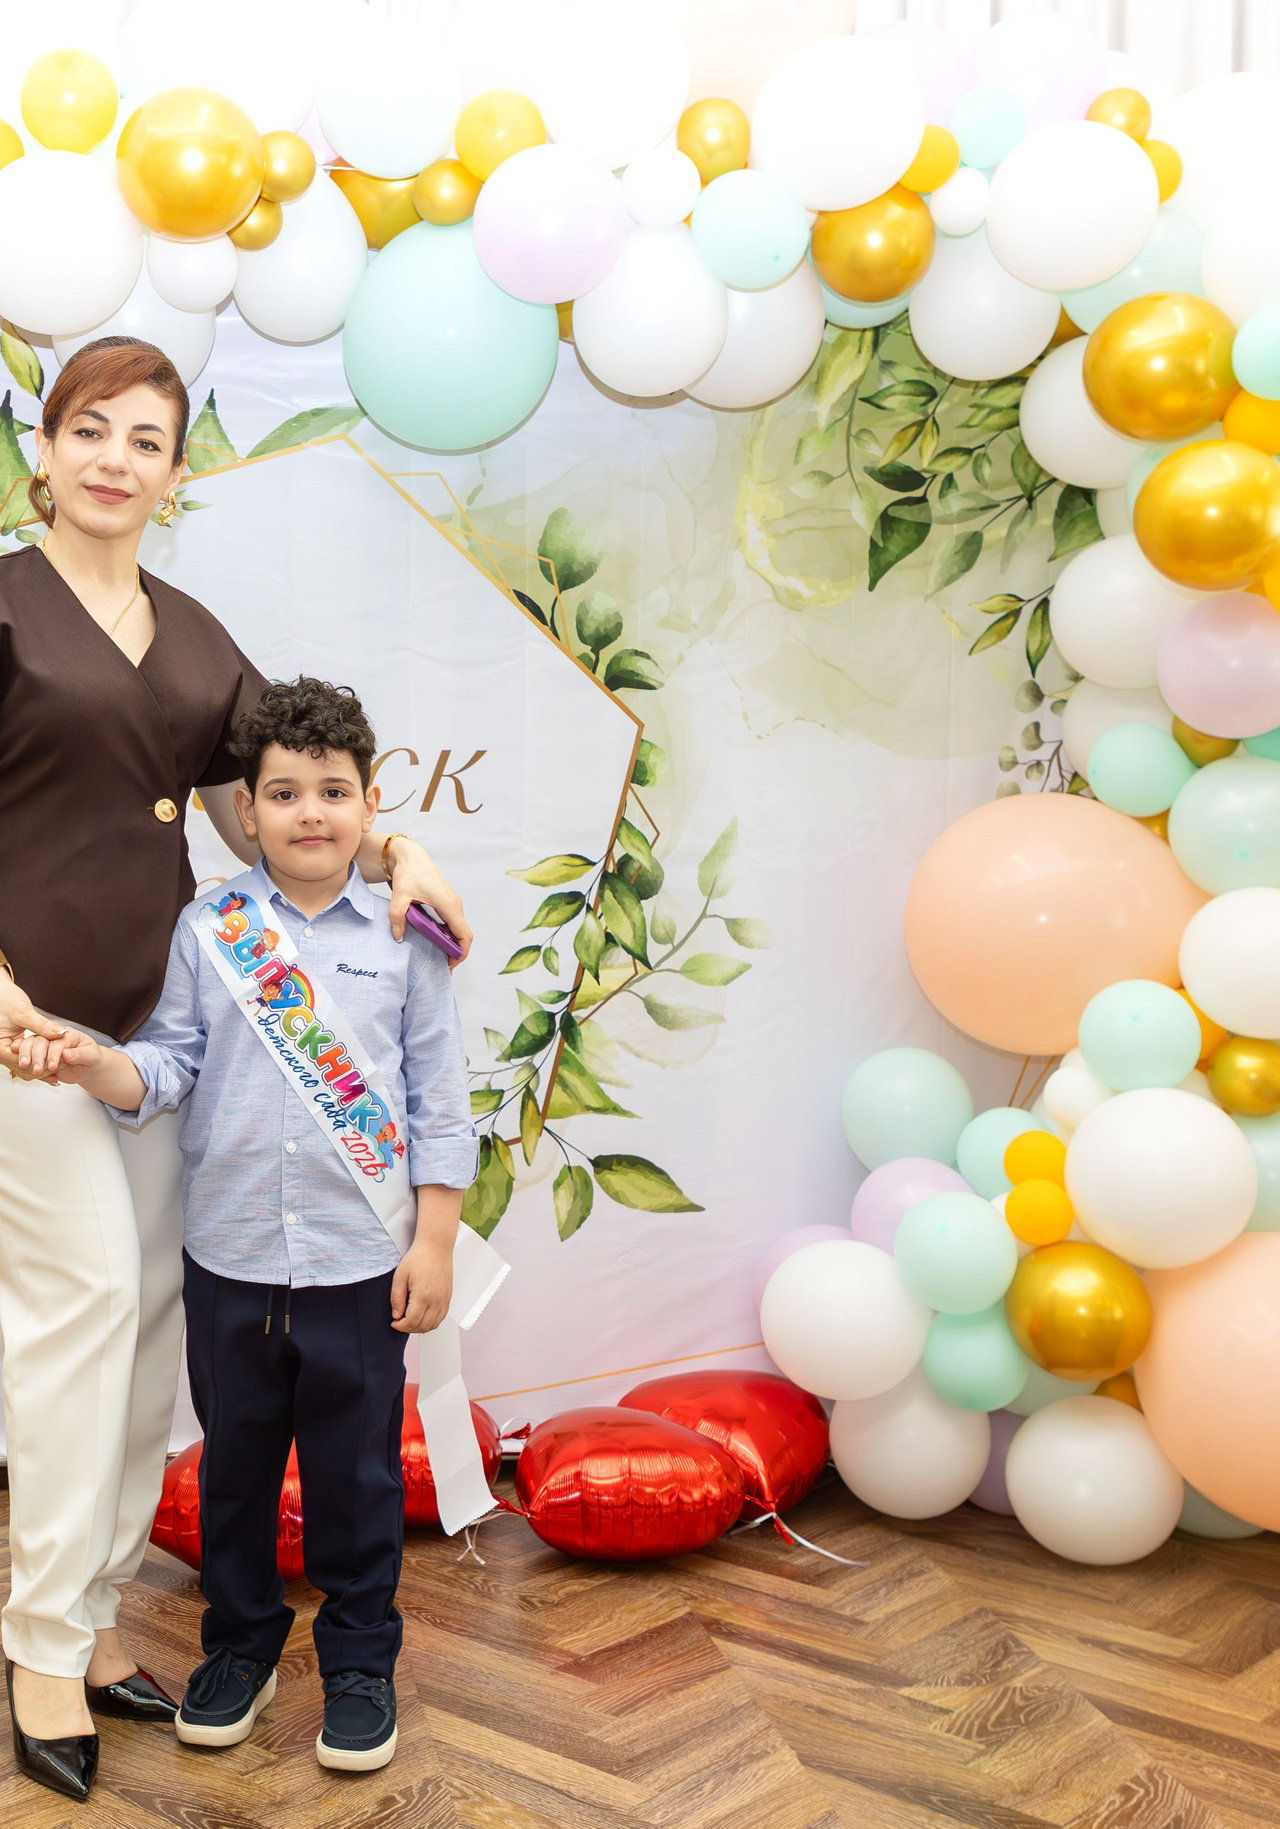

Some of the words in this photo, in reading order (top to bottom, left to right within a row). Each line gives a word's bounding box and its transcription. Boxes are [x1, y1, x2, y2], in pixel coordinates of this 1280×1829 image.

[213, 909, 382, 1134] ВЫПУСКНИК
[336, 963, 379, 978] Respect
[257, 1012, 319, 1089] детского
[313, 1091, 348, 1132] сада
[341, 1130, 389, 1177] 2026
